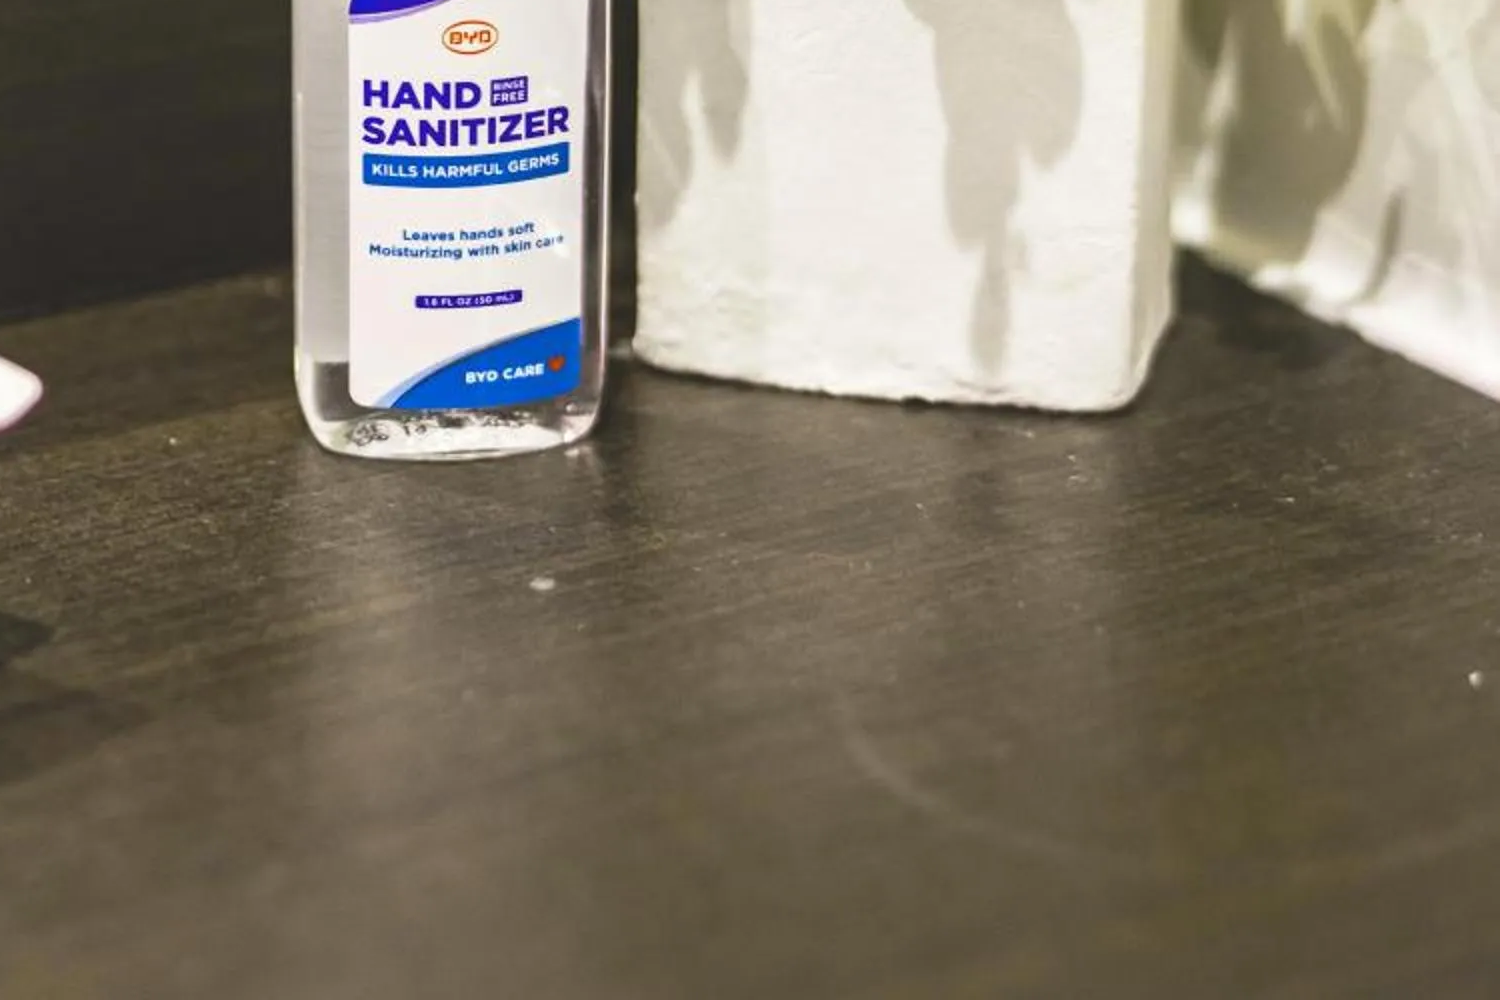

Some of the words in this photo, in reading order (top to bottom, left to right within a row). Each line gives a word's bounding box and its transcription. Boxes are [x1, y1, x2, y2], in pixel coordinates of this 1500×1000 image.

[362, 79, 482, 110] HAND
[493, 90, 525, 104] FREE
[362, 106, 570, 147] SANITIZER
[371, 164, 418, 178] KILLS
[423, 163, 503, 179] HARMFUL
[507, 153, 560, 173] GERMS
[402, 229, 455, 242] Leaves
[459, 226, 504, 241] hands
[508, 222, 535, 236] soft
[368, 244, 463, 260] Moisturizing
[467, 243, 499, 257] with
[504, 239, 532, 254] skin
[441, 297, 454, 307] FL
[457, 297, 472, 306] OZ
[465, 369, 499, 385] BYD
[502, 363, 546, 380] CARE
